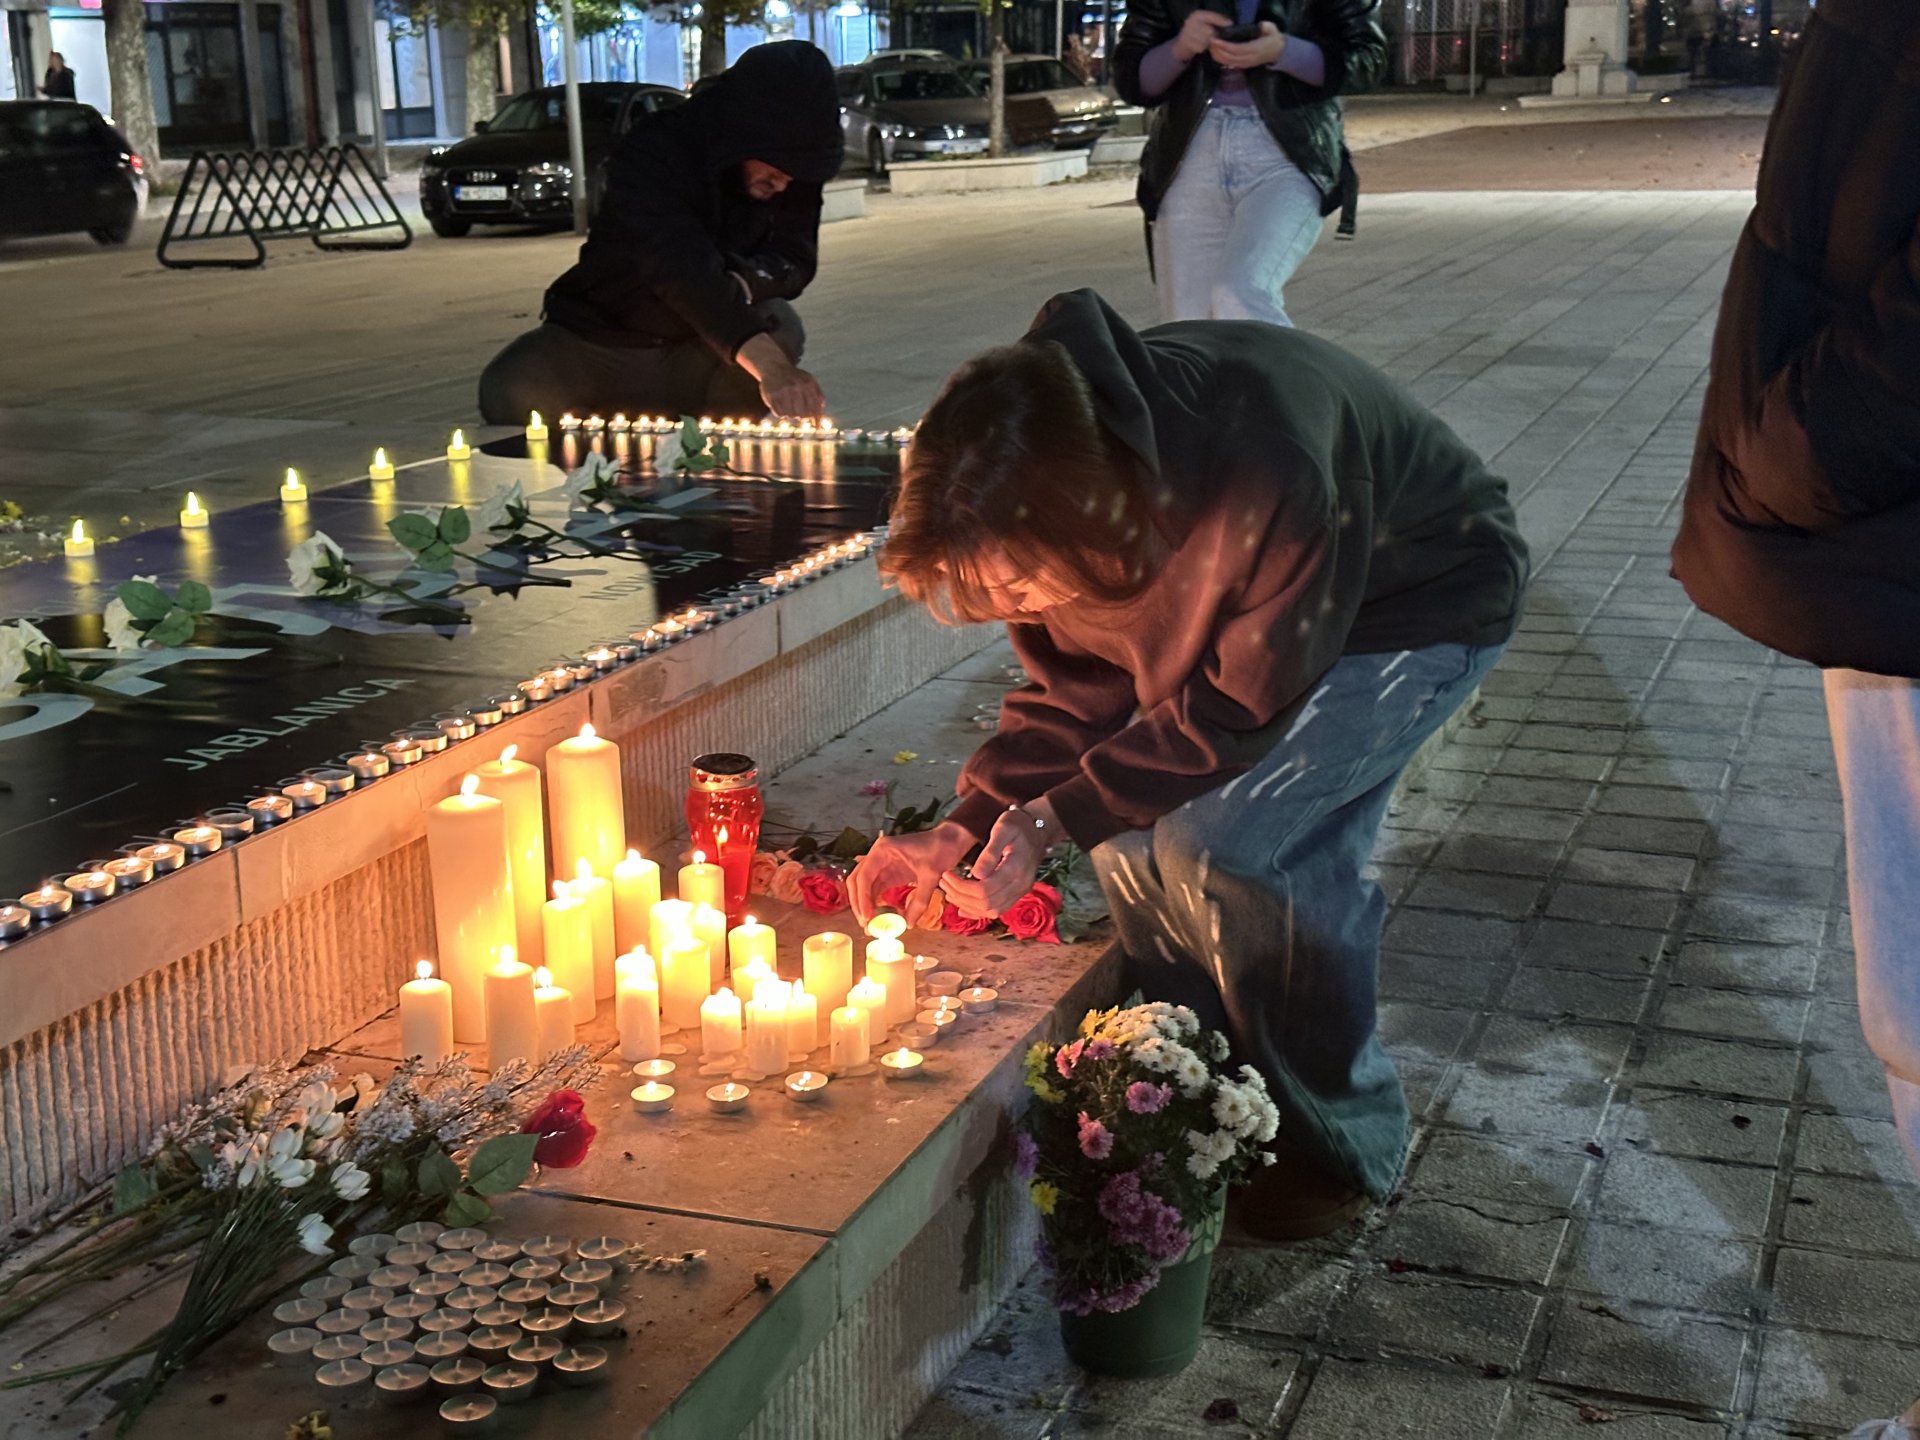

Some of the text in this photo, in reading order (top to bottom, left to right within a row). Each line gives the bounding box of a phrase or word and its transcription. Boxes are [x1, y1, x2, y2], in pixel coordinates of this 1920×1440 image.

[579, 573, 672, 601] NOVI
[651, 550, 723, 574] SAD
[162, 678, 417, 771] JABLANICA
